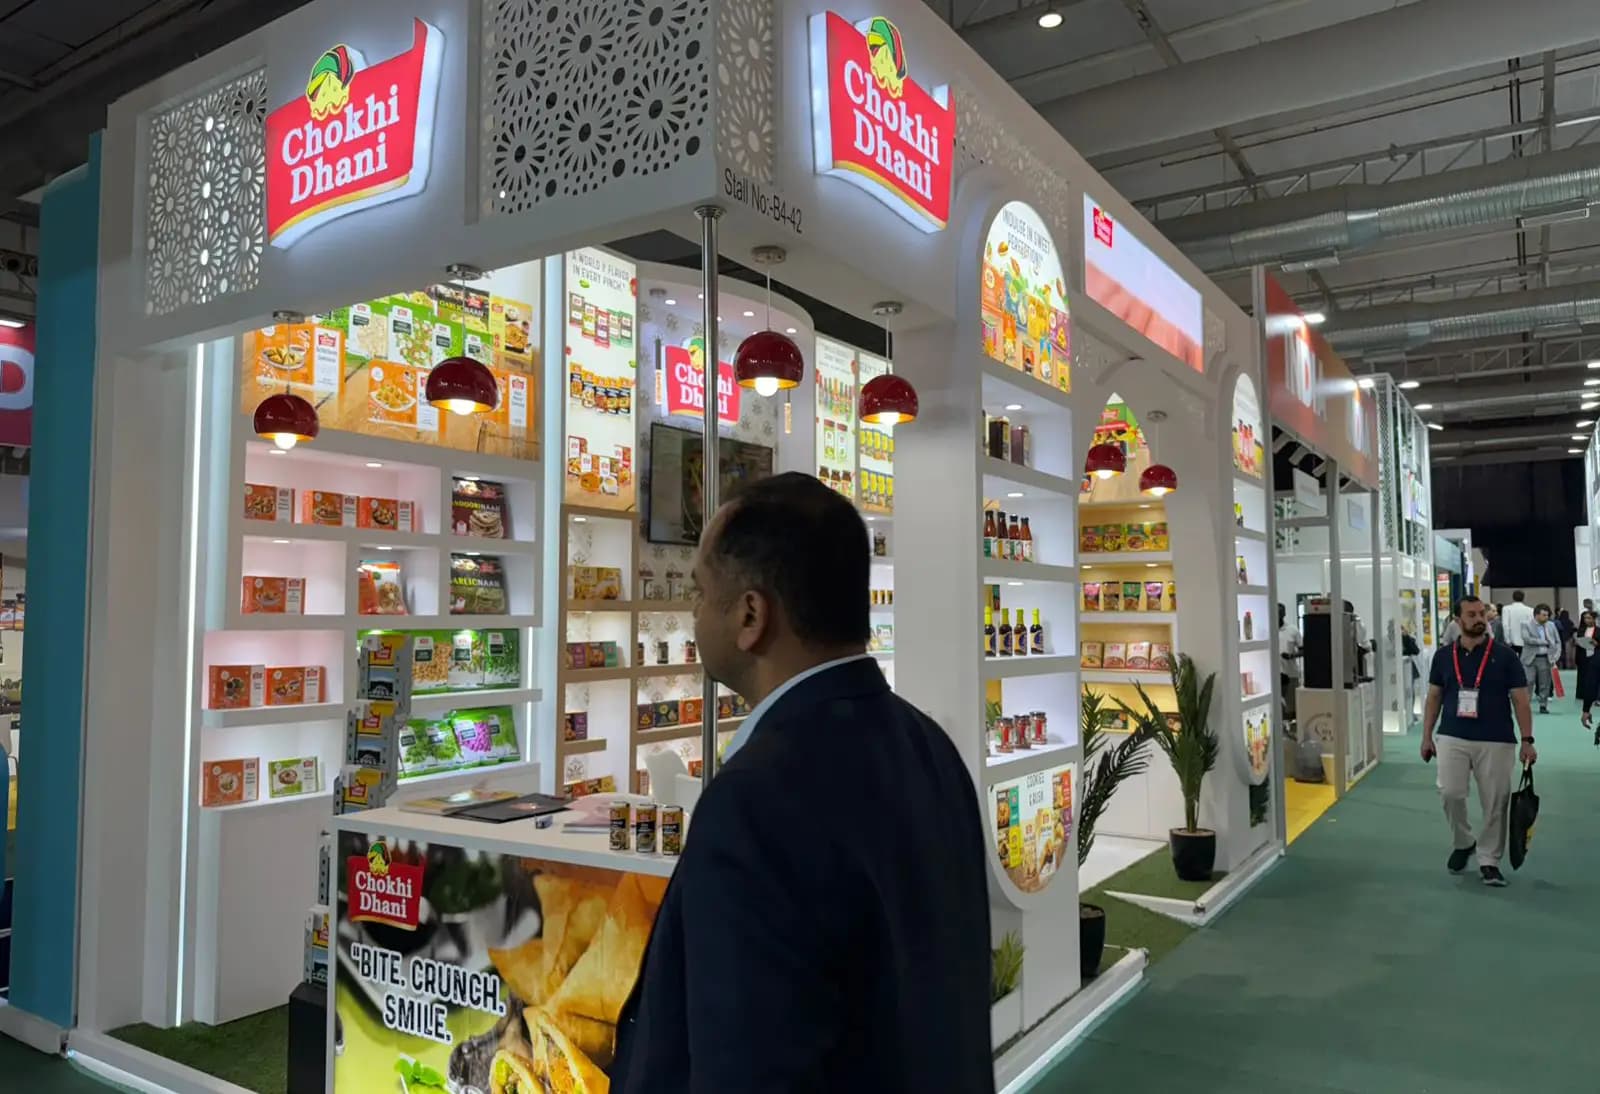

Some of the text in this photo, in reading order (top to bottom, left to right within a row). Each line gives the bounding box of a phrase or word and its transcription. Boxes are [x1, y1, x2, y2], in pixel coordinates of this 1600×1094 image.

[282, 84, 400, 166] Chokhi
[844, 60, 940, 165] Chokhi
[290, 132, 388, 205] Dhani
[853, 108, 933, 200] Dhani
[724, 168, 748, 205] Stall
[355, 870, 413, 899] Chokhi
[360, 891, 407, 919] Dhani
[411, 958, 505, 1013] CRUNCH.
[384, 993, 452, 1041] SMILE.
